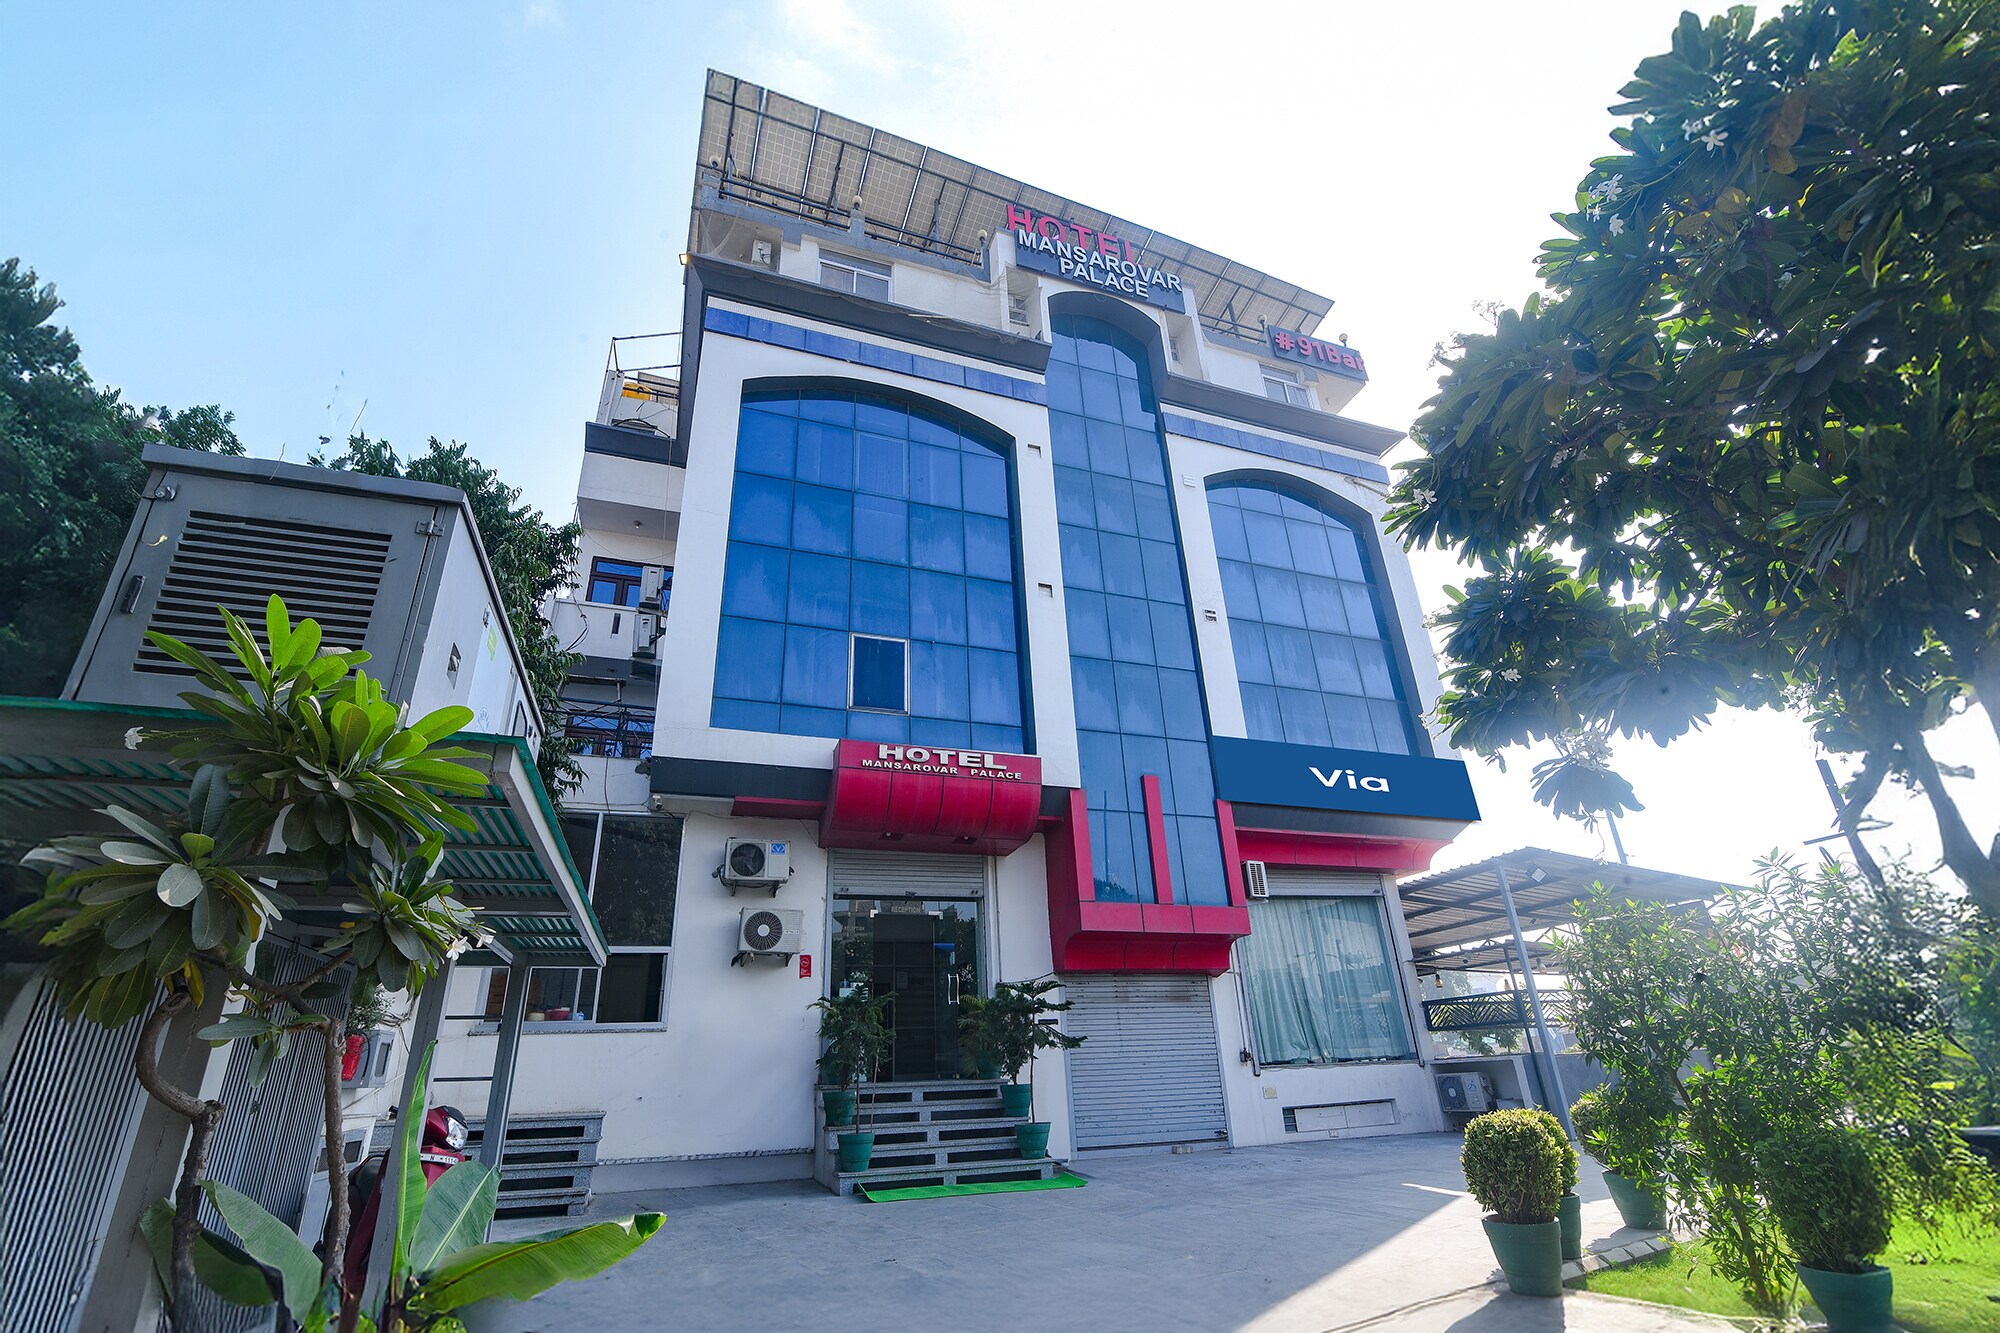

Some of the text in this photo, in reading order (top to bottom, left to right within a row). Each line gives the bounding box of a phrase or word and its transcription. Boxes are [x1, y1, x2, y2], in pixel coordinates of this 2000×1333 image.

[1007, 204, 1145, 267] HOTEL
[1018, 229, 1182, 292] MANSAROVAR
[1060, 258, 1149, 297] PALACE
[862, 759, 1022, 780] MANSAROVAR PALACE
[878, 744, 1007, 770] HOTEL
[1309, 767, 1390, 792] Via
